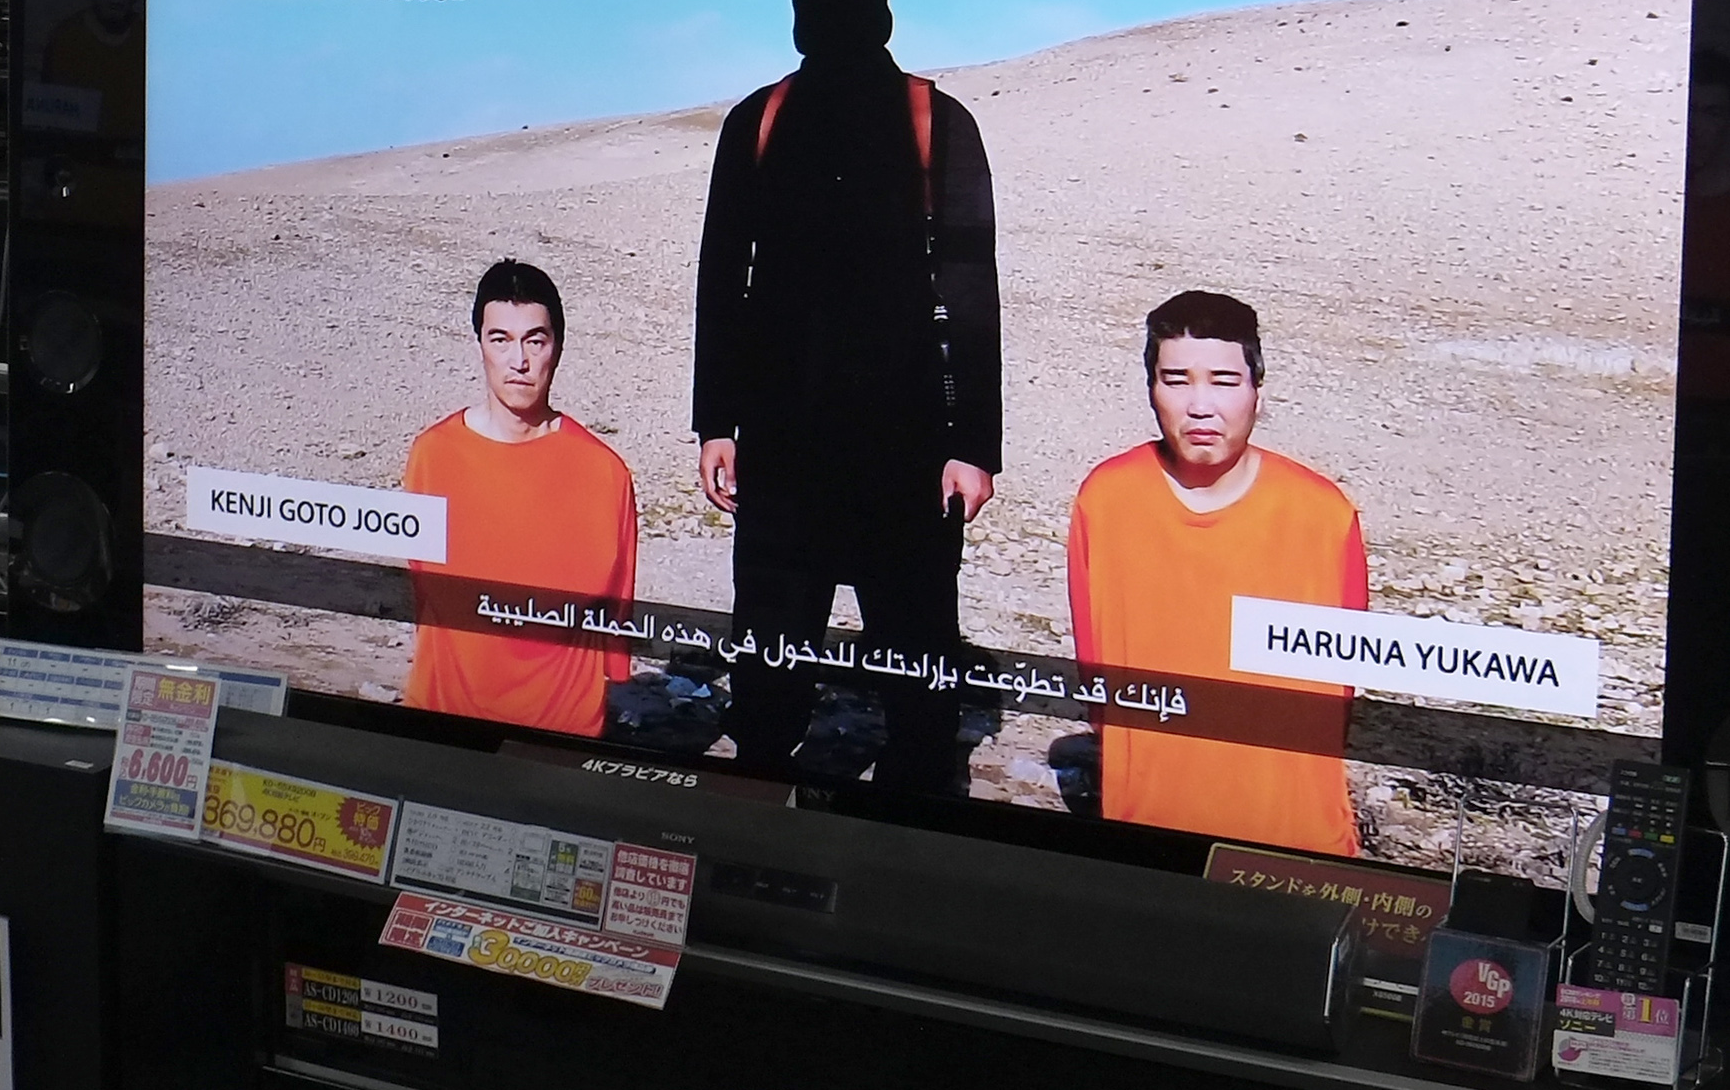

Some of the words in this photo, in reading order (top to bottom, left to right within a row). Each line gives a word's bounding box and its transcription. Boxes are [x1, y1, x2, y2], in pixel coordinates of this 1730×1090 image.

[211, 489, 272, 519] KENJI
[279, 498, 346, 528] GOTO
[352, 507, 420, 538] JOGO
[476, 592, 574, 628] الصليبية
[580, 609, 654, 641] الحملة
[660, 620, 712, 649] هذه
[718, 627, 757, 662] في
[763, 633, 856, 671] للدخول
[862, 645, 958, 690] بإرادتك
[1267, 624, 1406, 668] HARUNA
[1414, 642, 1559, 687] YUKAWA
[157, 677, 212, 706] 無金利
[965, 660, 1065, 701] تطوّعت
[1072, 677, 1106, 704] قد
[1114, 681, 1187, 722] فإنك
[127, 747, 199, 790] 6,600円
[581, 758, 699, 789] 4Kブラビアなら
[660, 831, 696, 846] SONY
[424, 900, 650, 959] インターネットご加入キャンペーン
[304, 981, 360, 1006] AS-CD1200
[377, 988, 419, 1010] 1200
[1477, 961, 1511, 999] VGP
[1462, 991, 1495, 1009] 2015
[1560, 1008, 1613, 1025] 4K対応テレビ
[376, 1020, 419, 1042] 1400
[1560, 1019, 1597, 1031] ソニー
